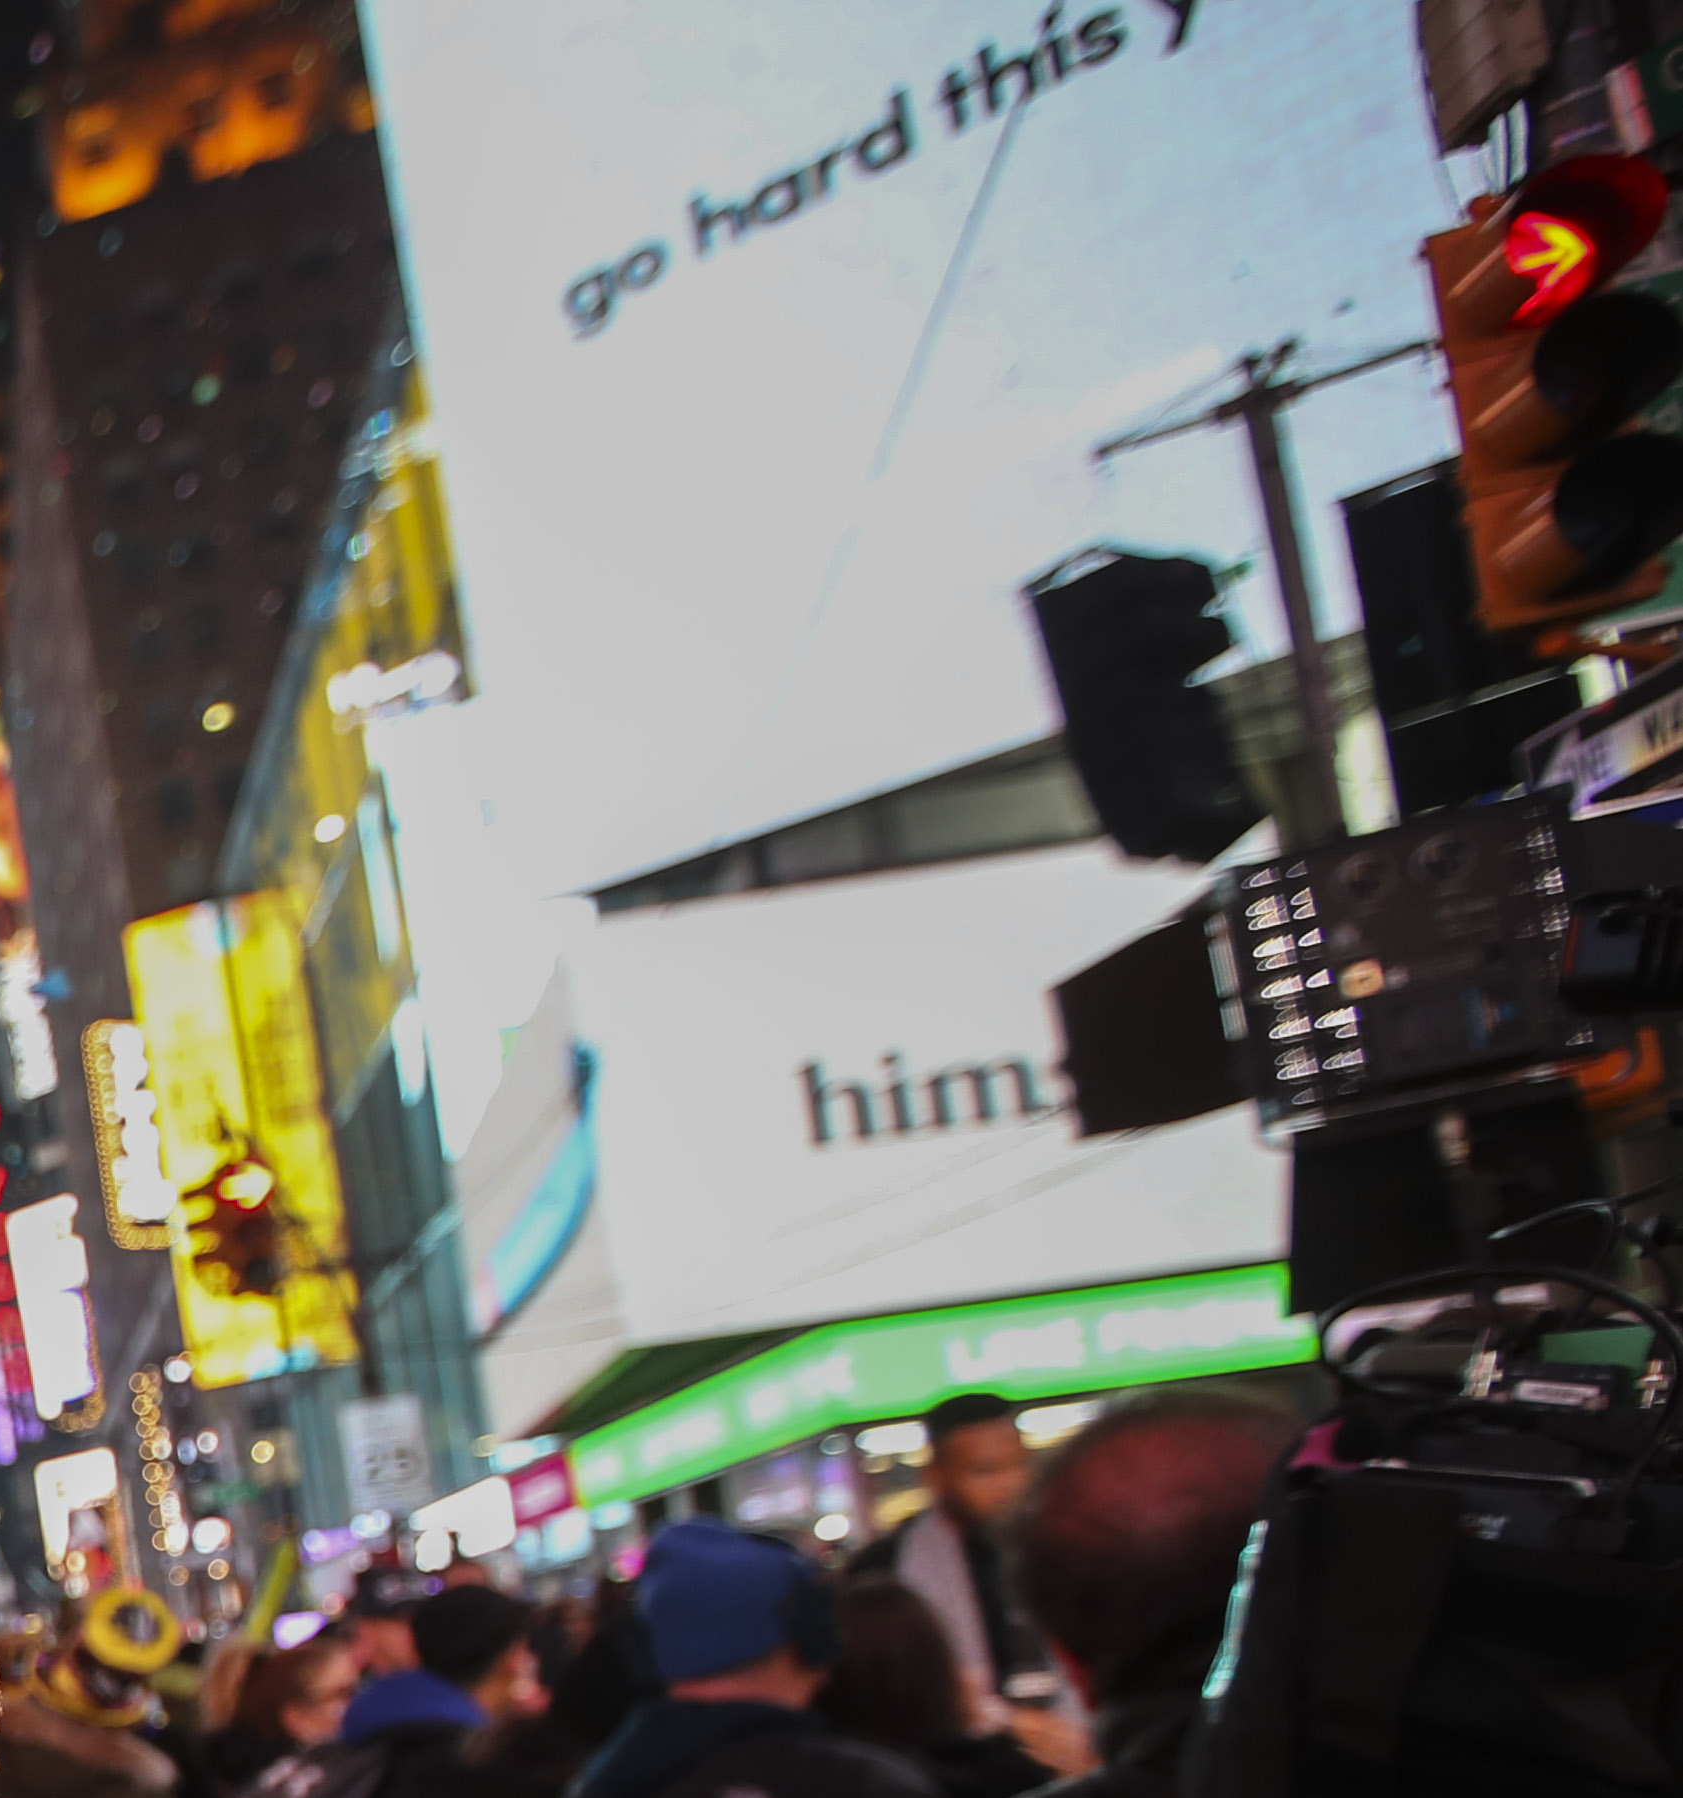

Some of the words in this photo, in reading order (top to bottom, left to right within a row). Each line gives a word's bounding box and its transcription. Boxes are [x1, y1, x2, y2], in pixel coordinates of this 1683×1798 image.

[563, 241, 670, 339] go
[688, 86, 919, 257] hard
[934, 0, 1130, 137] this
[794, 1046, 1049, 1147] him
